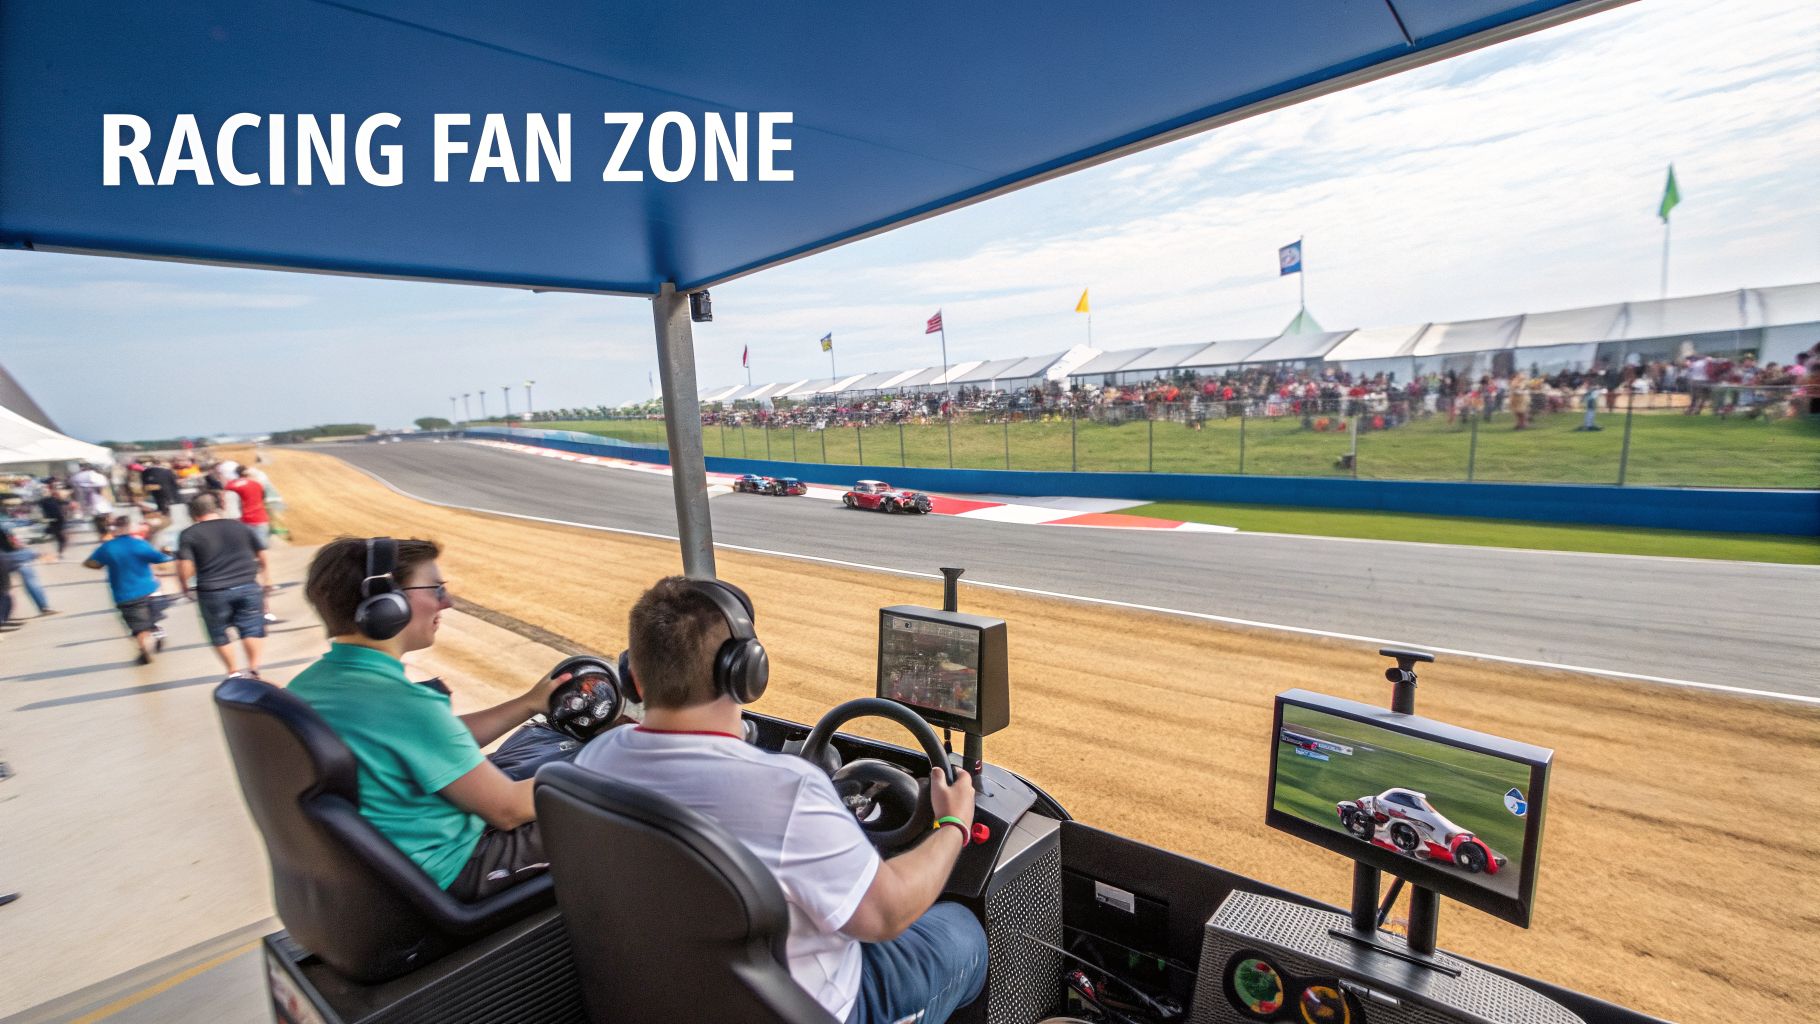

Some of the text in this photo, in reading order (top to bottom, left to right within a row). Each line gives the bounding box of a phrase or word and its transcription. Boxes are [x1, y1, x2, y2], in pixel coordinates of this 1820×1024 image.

[103, 111, 794, 187] RACING FAN ZONE
